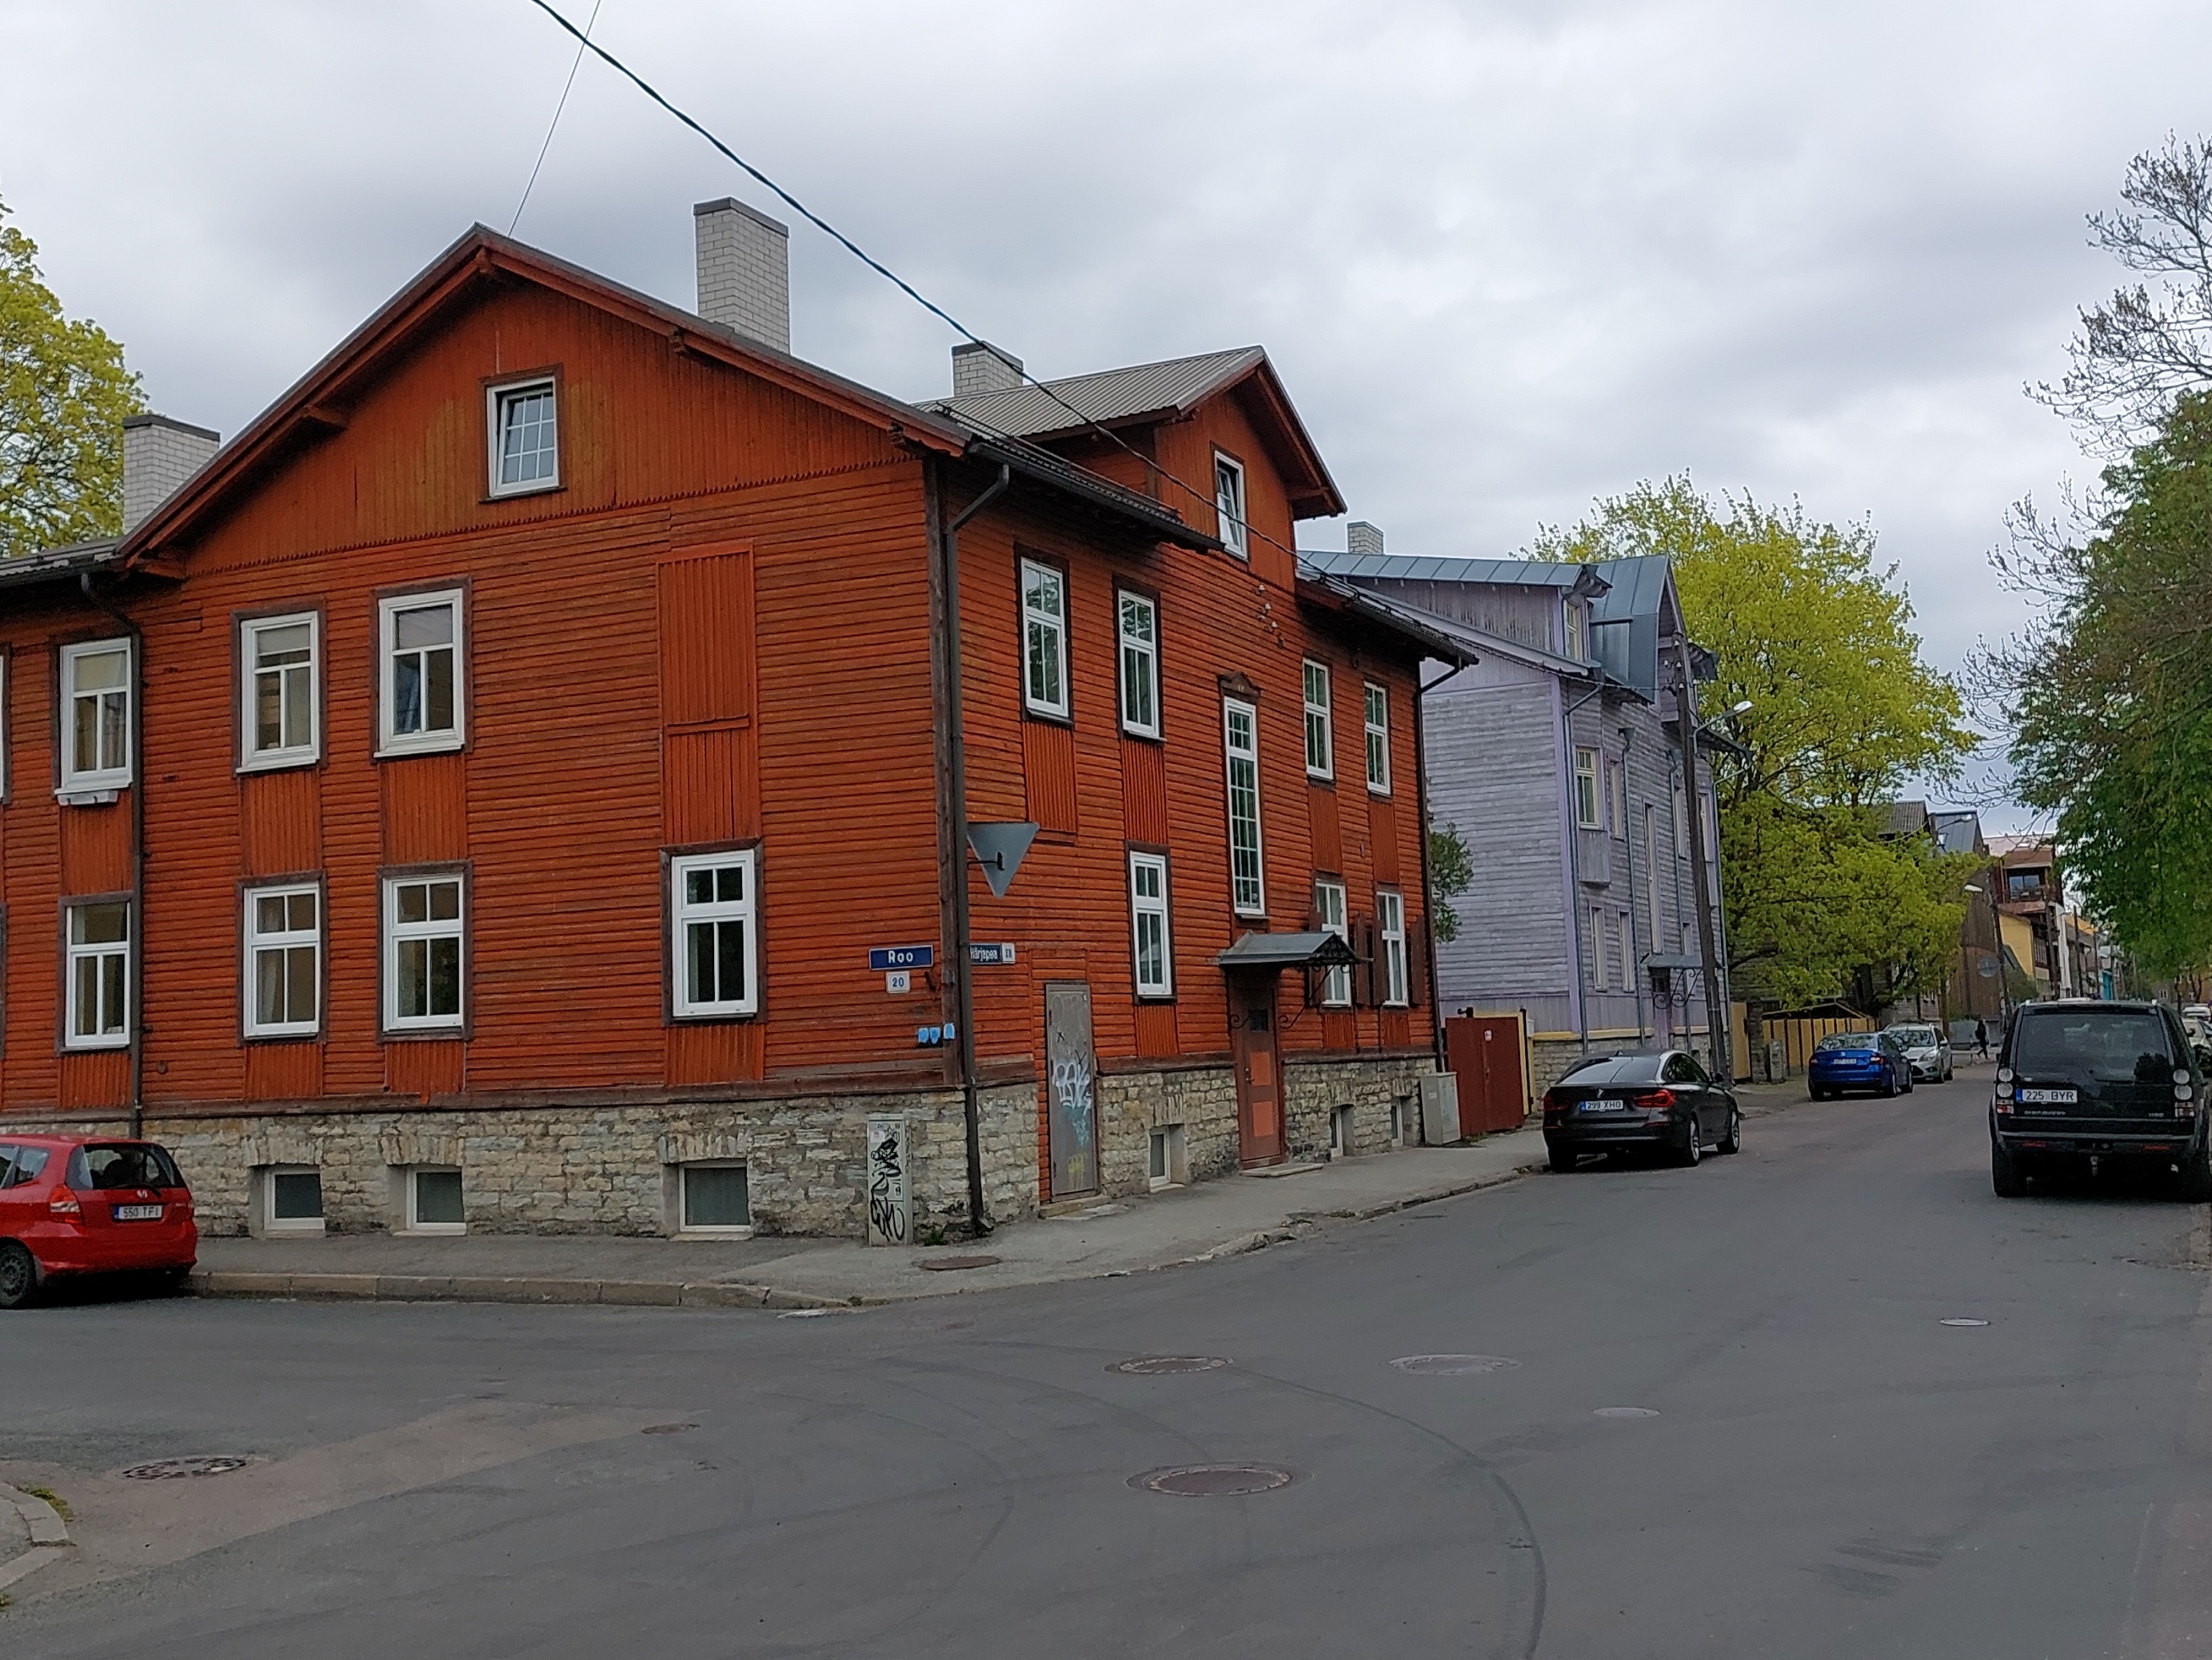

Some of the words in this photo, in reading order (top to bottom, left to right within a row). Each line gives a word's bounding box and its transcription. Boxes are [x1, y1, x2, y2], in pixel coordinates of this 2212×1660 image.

[888, 950, 913, 964] Roo
[892, 976, 904, 988] 20
[2026, 1090, 2044, 1101] 225
[2050, 1091, 2074, 1101] BYR
[1587, 1101, 1601, 1110] 299
[123, 1207, 139, 1218] 550
